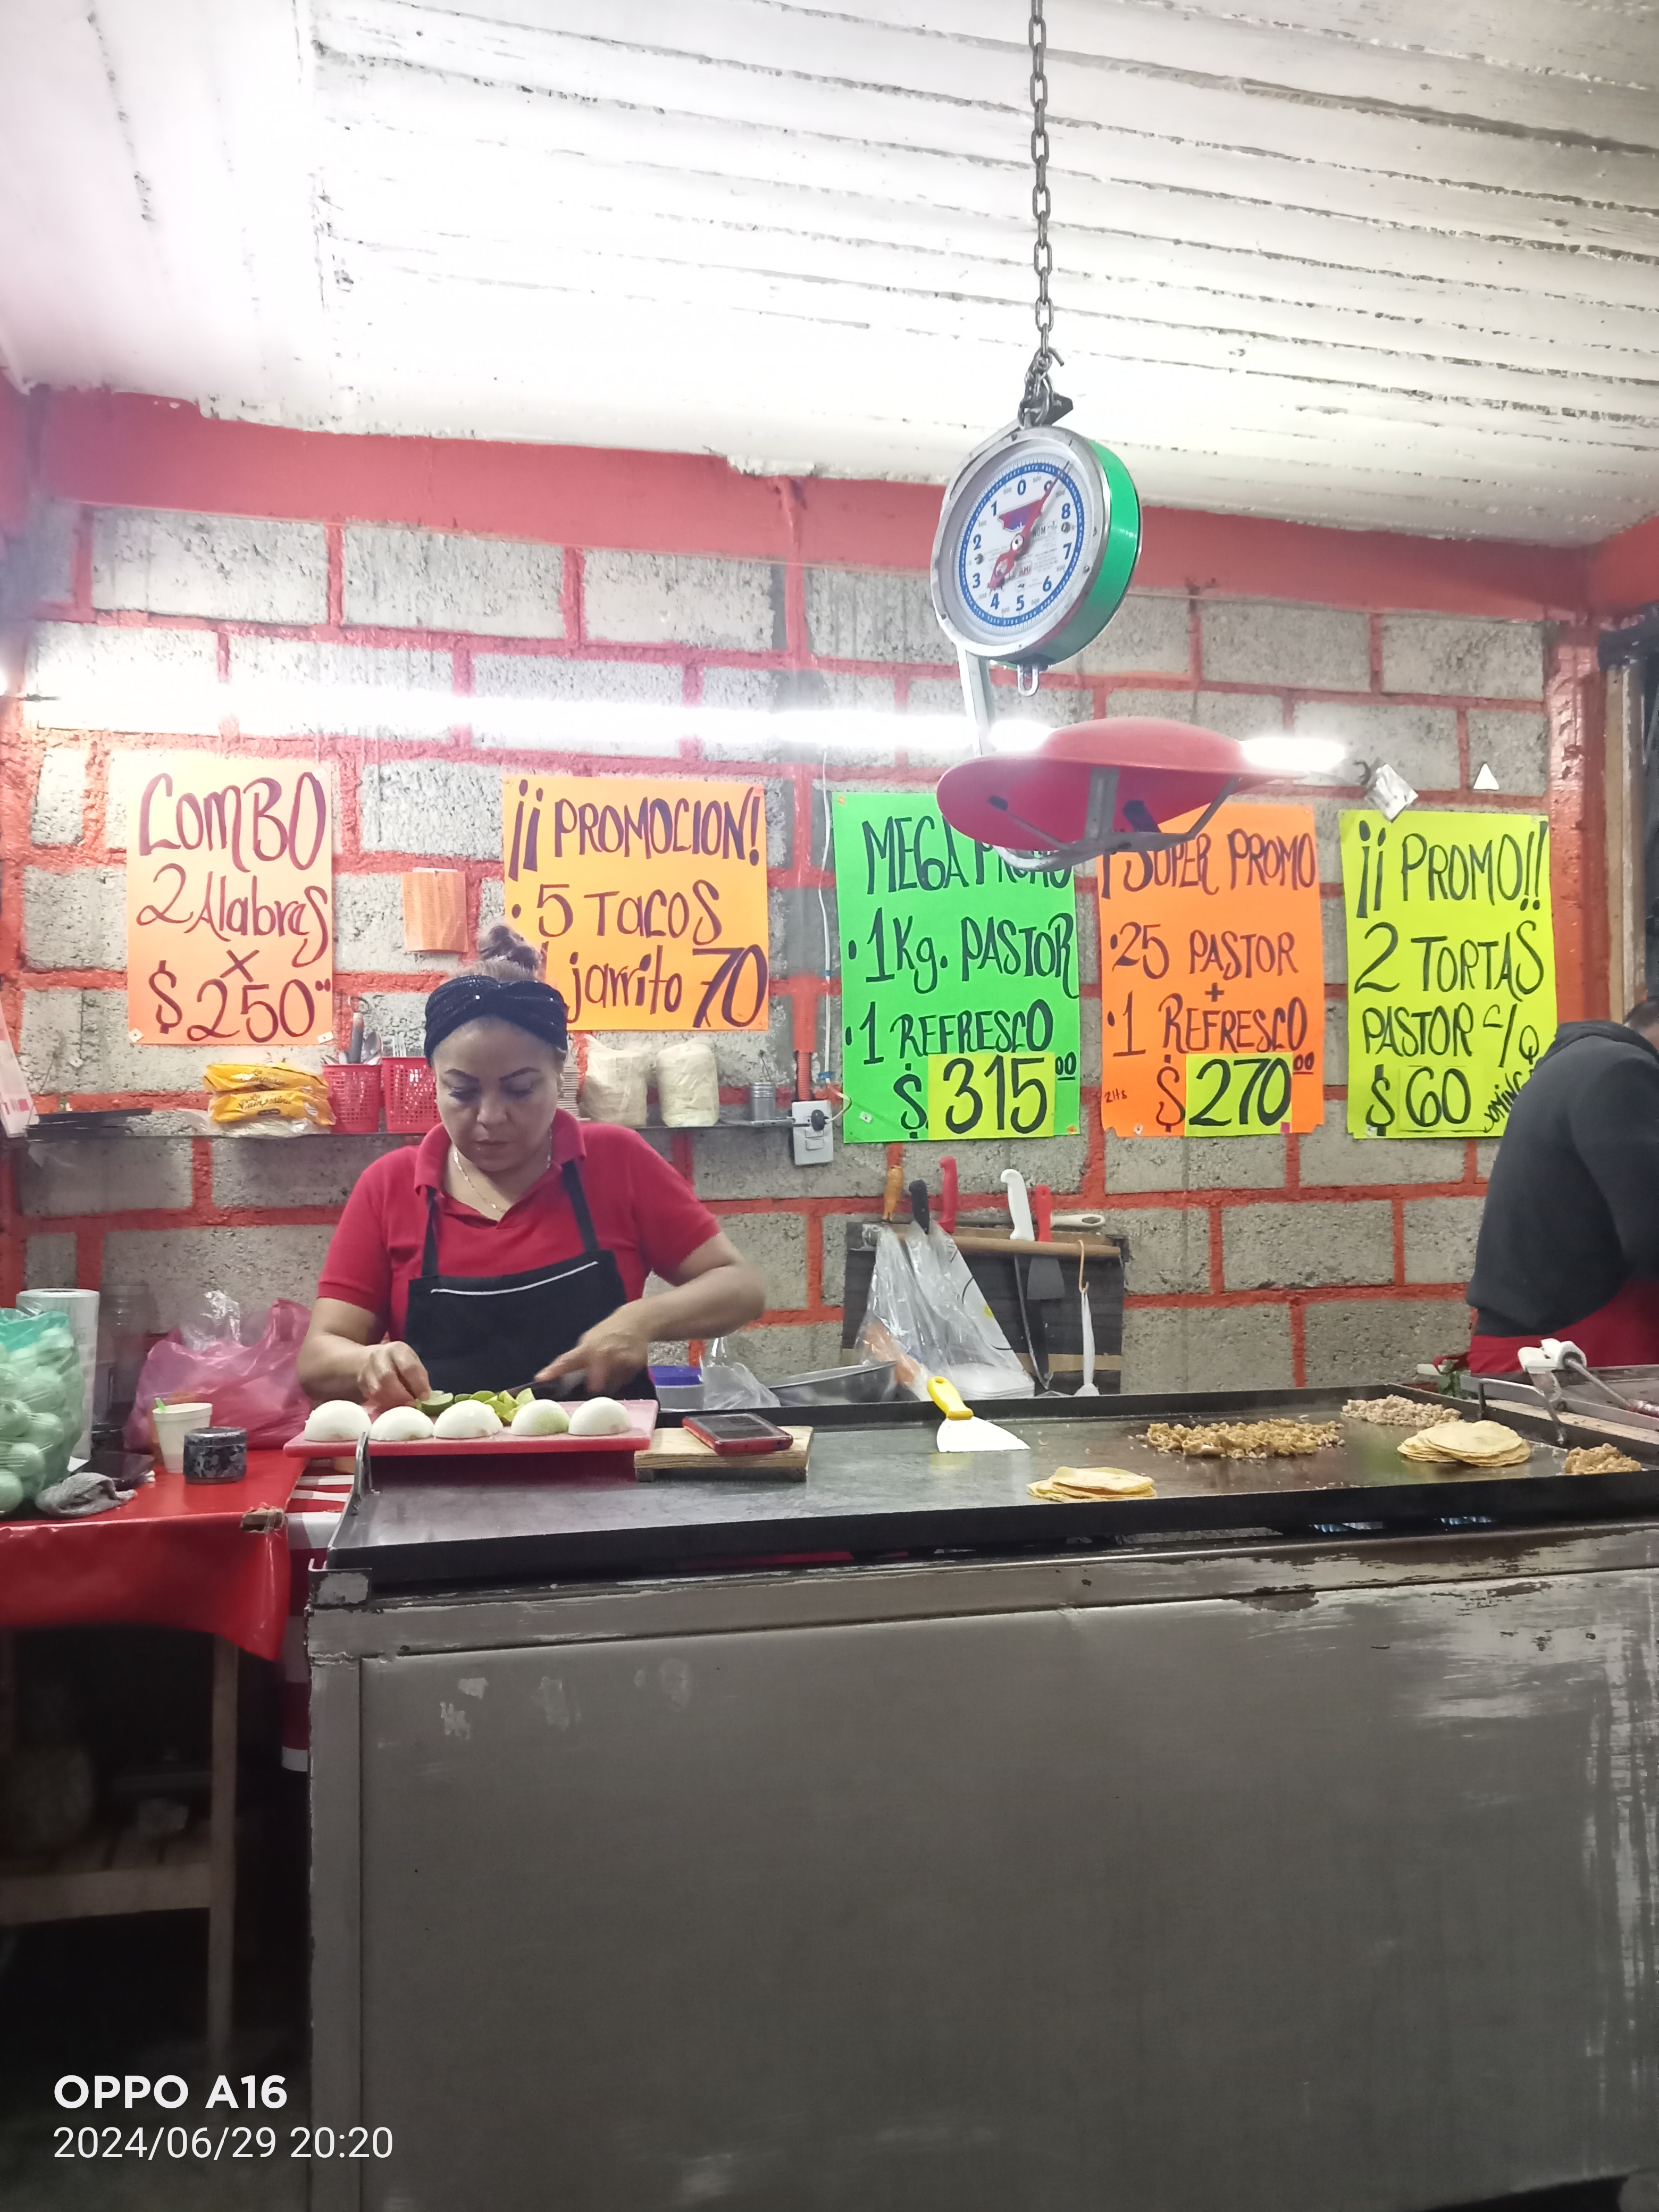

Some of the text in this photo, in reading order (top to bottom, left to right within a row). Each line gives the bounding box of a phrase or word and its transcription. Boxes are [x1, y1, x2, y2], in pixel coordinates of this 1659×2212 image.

[991, 500, 997, 516] 1
[1017, 479, 1026, 496] 0
[1061, 503, 1071, 520] 8
[973, 533, 982, 551] 2
[1063, 542, 1072, 560] 7
[972, 572, 981, 589] 3
[990, 593, 1000, 610] 4
[1016, 594, 1025, 611] 5
[1042, 575, 1052, 592] 6
[861, 815, 969, 895] MEGA
[1227, 828, 1317, 891] PROMO
[136, 863, 194, 926] 2
[537, 884, 574, 937] 5
[960, 912, 1079, 999] PASTOR
[1112, 921, 1299, 981] 25 PASTOR
[1354, 920, 1544, 1003] 2 TORTAS
[692, 943, 768, 1028] 70
[859, 999, 1054, 1065] 1 REFRESCO
[1112, 990, 1309, 1058] 1 REFRESCO
[1362, 1002, 1474, 1057] PASTOR
